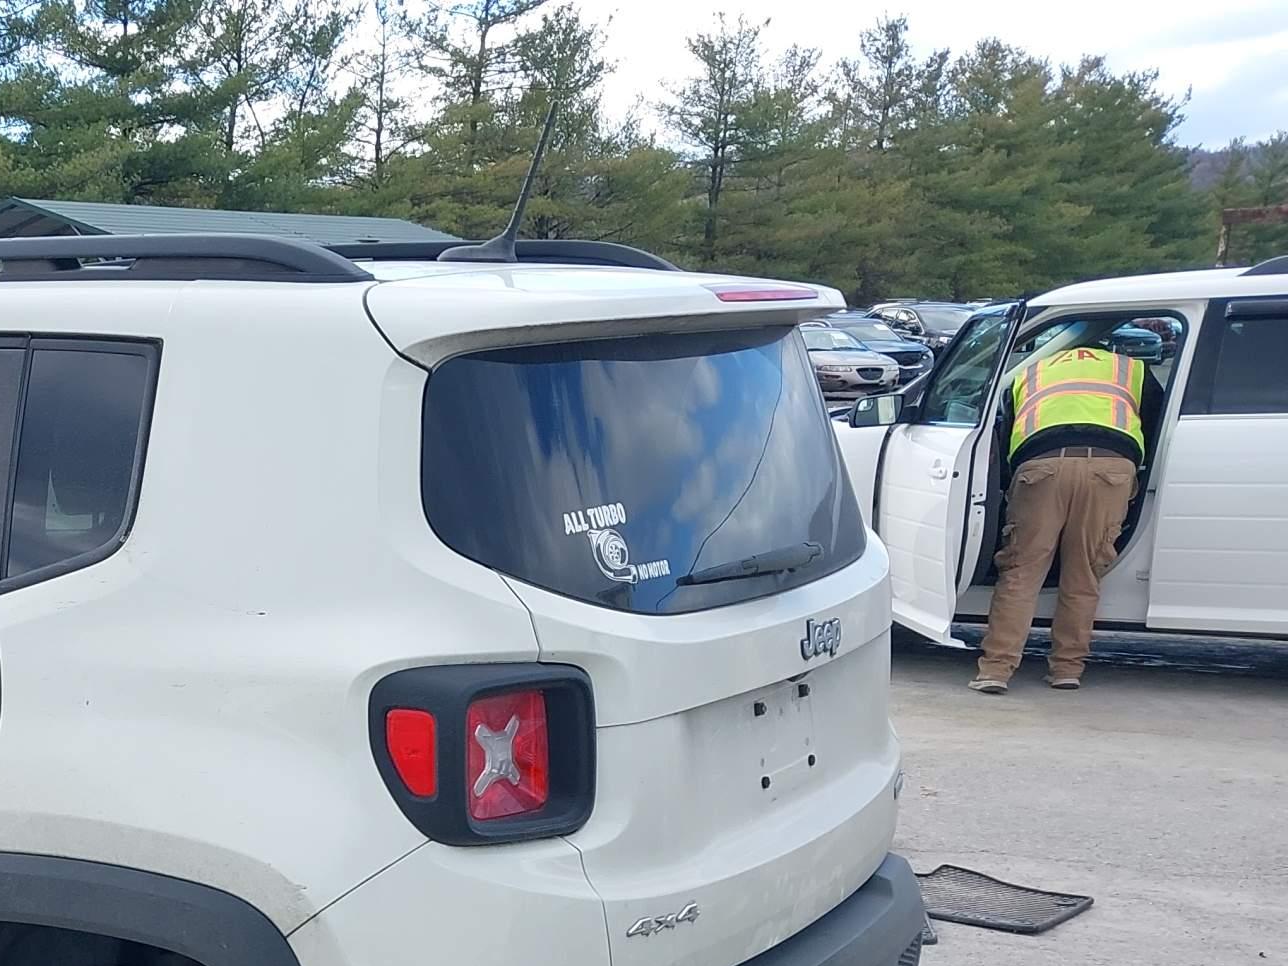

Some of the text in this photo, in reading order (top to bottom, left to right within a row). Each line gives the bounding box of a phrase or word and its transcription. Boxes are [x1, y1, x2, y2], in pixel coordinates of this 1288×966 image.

[563, 502, 626, 535] ALL TURBO
[637, 559, 671, 580] NO MOTOR
[801, 617, 841, 660] Jeep
[626, 901, 702, 938] 4x4
